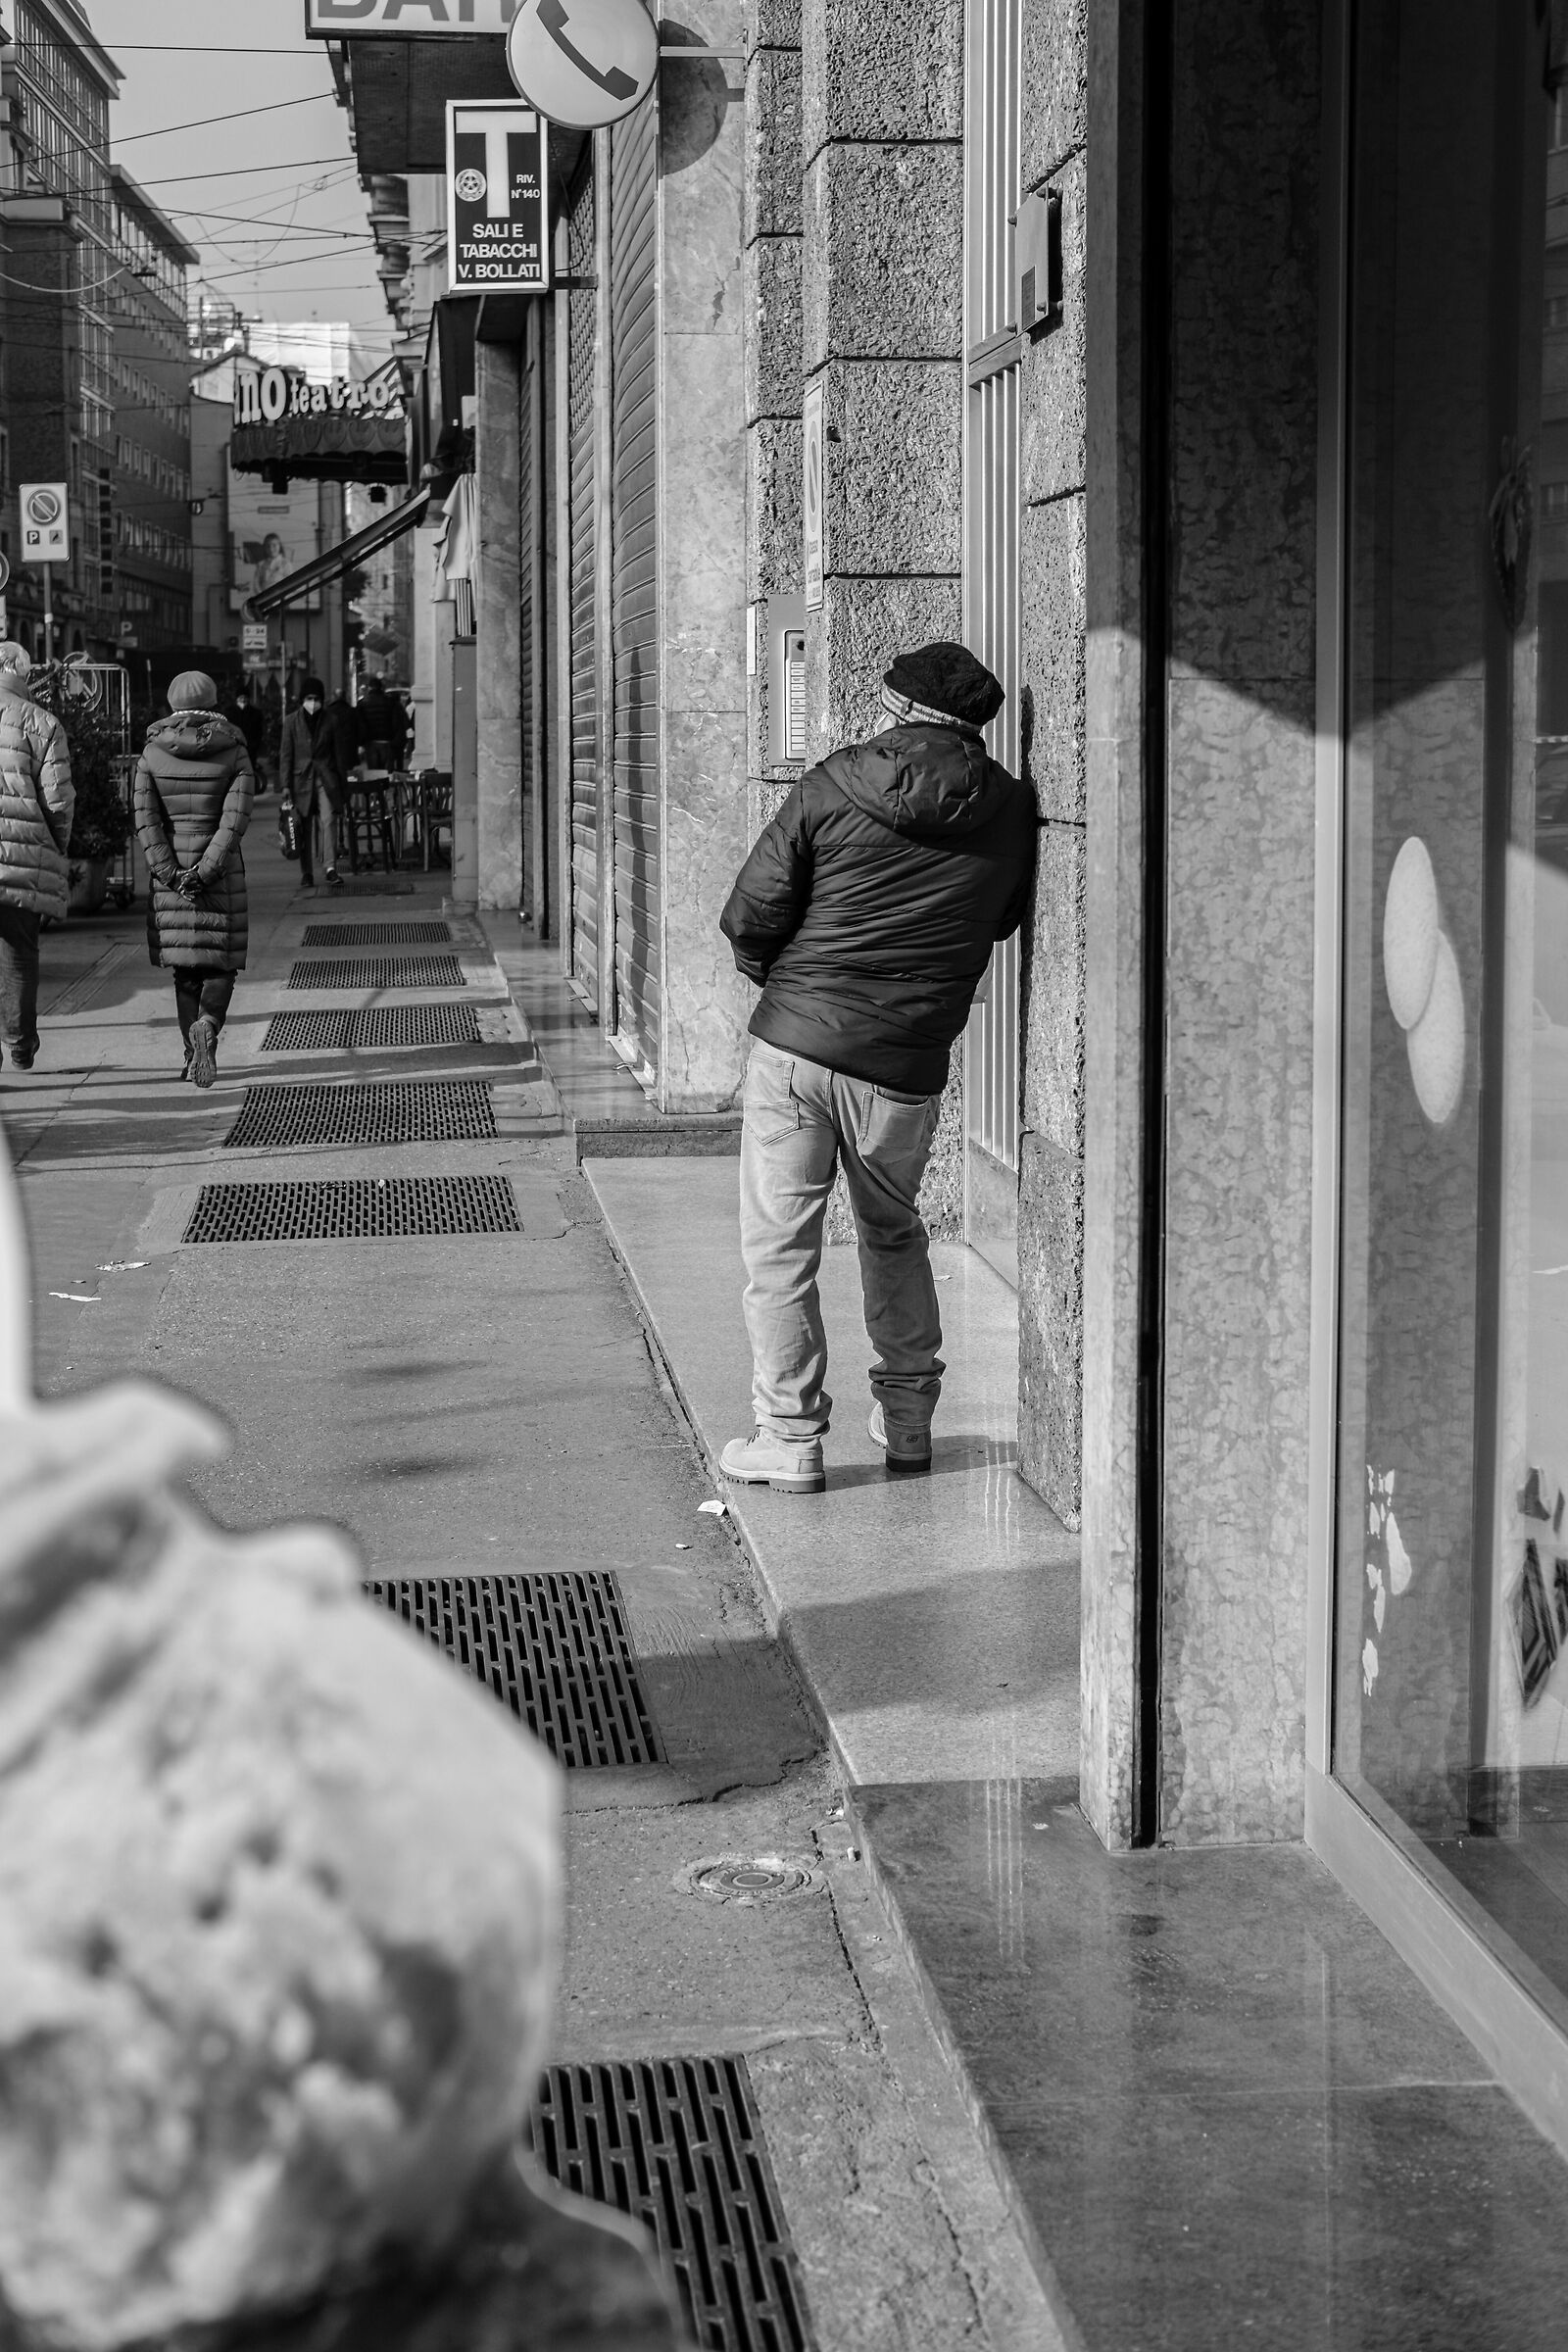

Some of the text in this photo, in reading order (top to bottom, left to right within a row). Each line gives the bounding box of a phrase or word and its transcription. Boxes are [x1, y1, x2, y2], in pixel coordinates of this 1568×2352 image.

[456, 112, 537, 218] T
[515, 174, 536, 183] RIV.
[472, 223, 524, 238] SALI E
[460, 244, 538, 259] TABACCHI
[458, 264, 540, 278] V. BOLLATI
[289, 375, 389, 416] teatro
